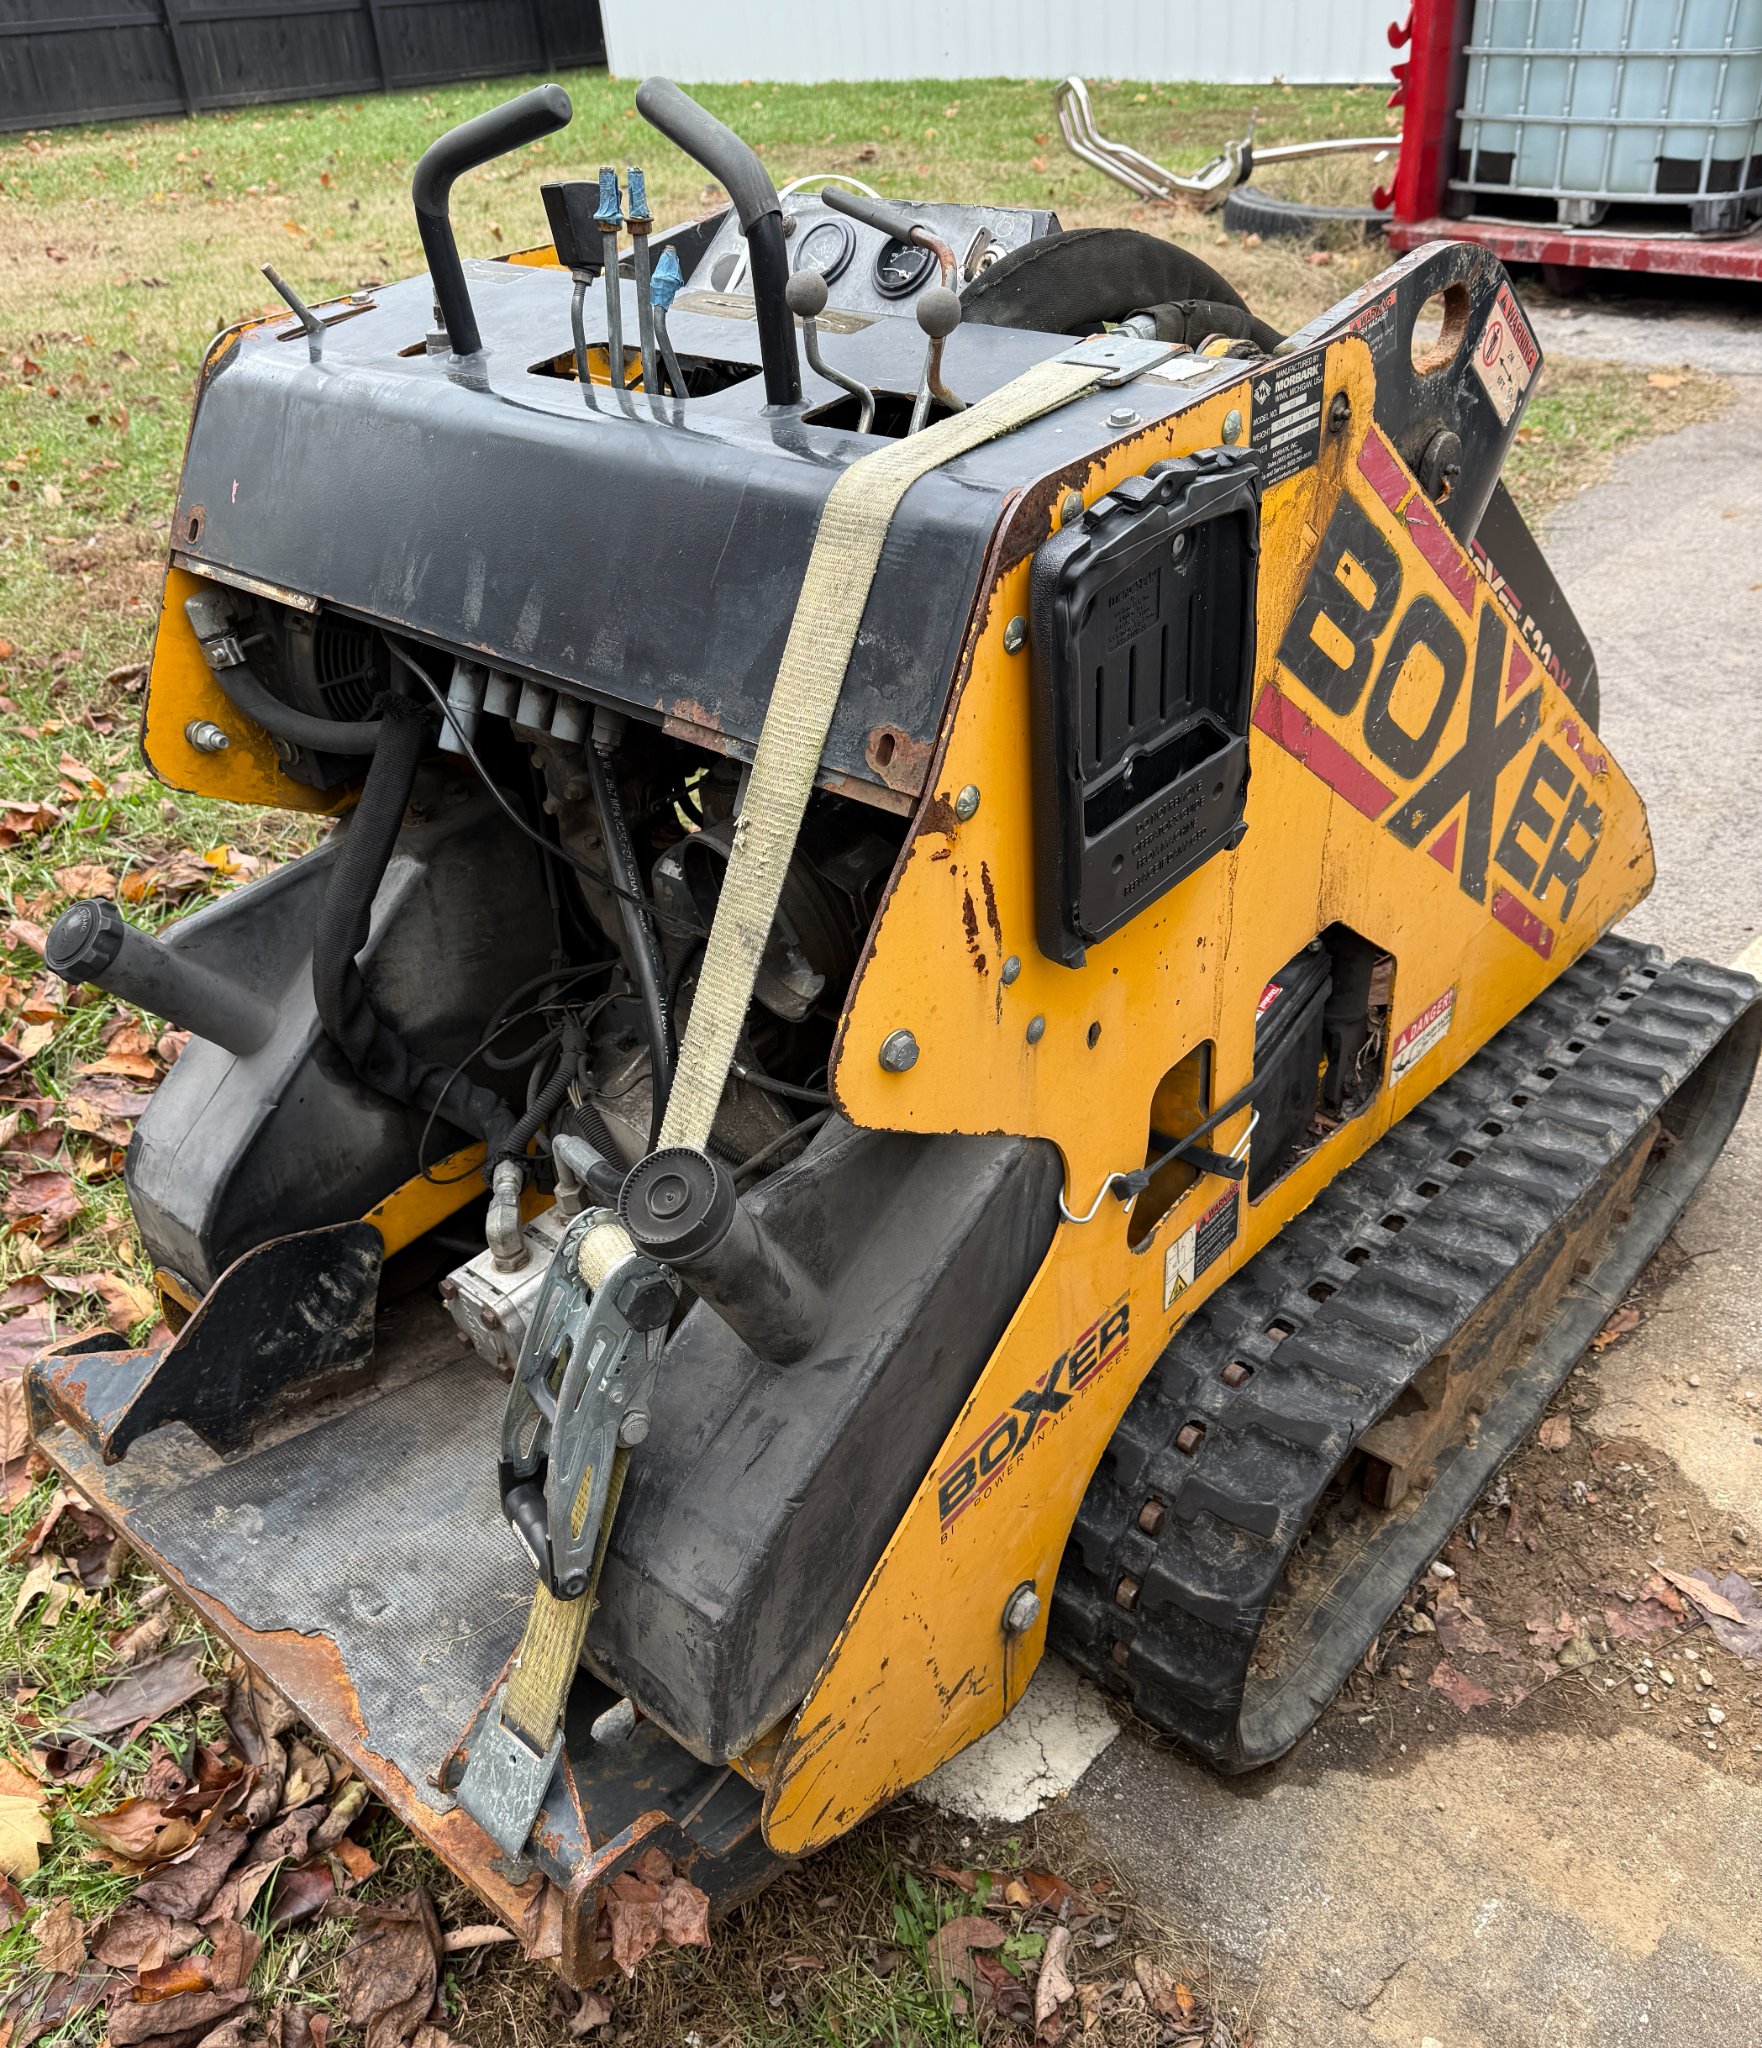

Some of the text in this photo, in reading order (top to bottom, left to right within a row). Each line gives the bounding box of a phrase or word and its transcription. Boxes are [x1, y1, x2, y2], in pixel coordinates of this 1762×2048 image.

[1506, 306, 1536, 366] WARNING
[1275, 356, 1313, 380] MANUFACTURED
[1314, 375, 1324, 386] USA
[1252, 413, 1270, 426] MODEL
[1277, 490, 1602, 923] BOXER
[1136, 780, 1202, 836] DO NOT REMOVE
[1180, 795, 1205, 820] GUIDE
[1124, 862, 1159, 897] REPLACE
[1166, 826, 1207, 866] DAMAGED
[1136, 816, 1198, 870] FROM MACHINE
[1410, 989, 1453, 1040] DANGER!
[938, 1303, 1130, 1522] BOXER
[1031, 1431, 1045, 1451] IN
[1051, 1404, 1075, 1431] ALL
